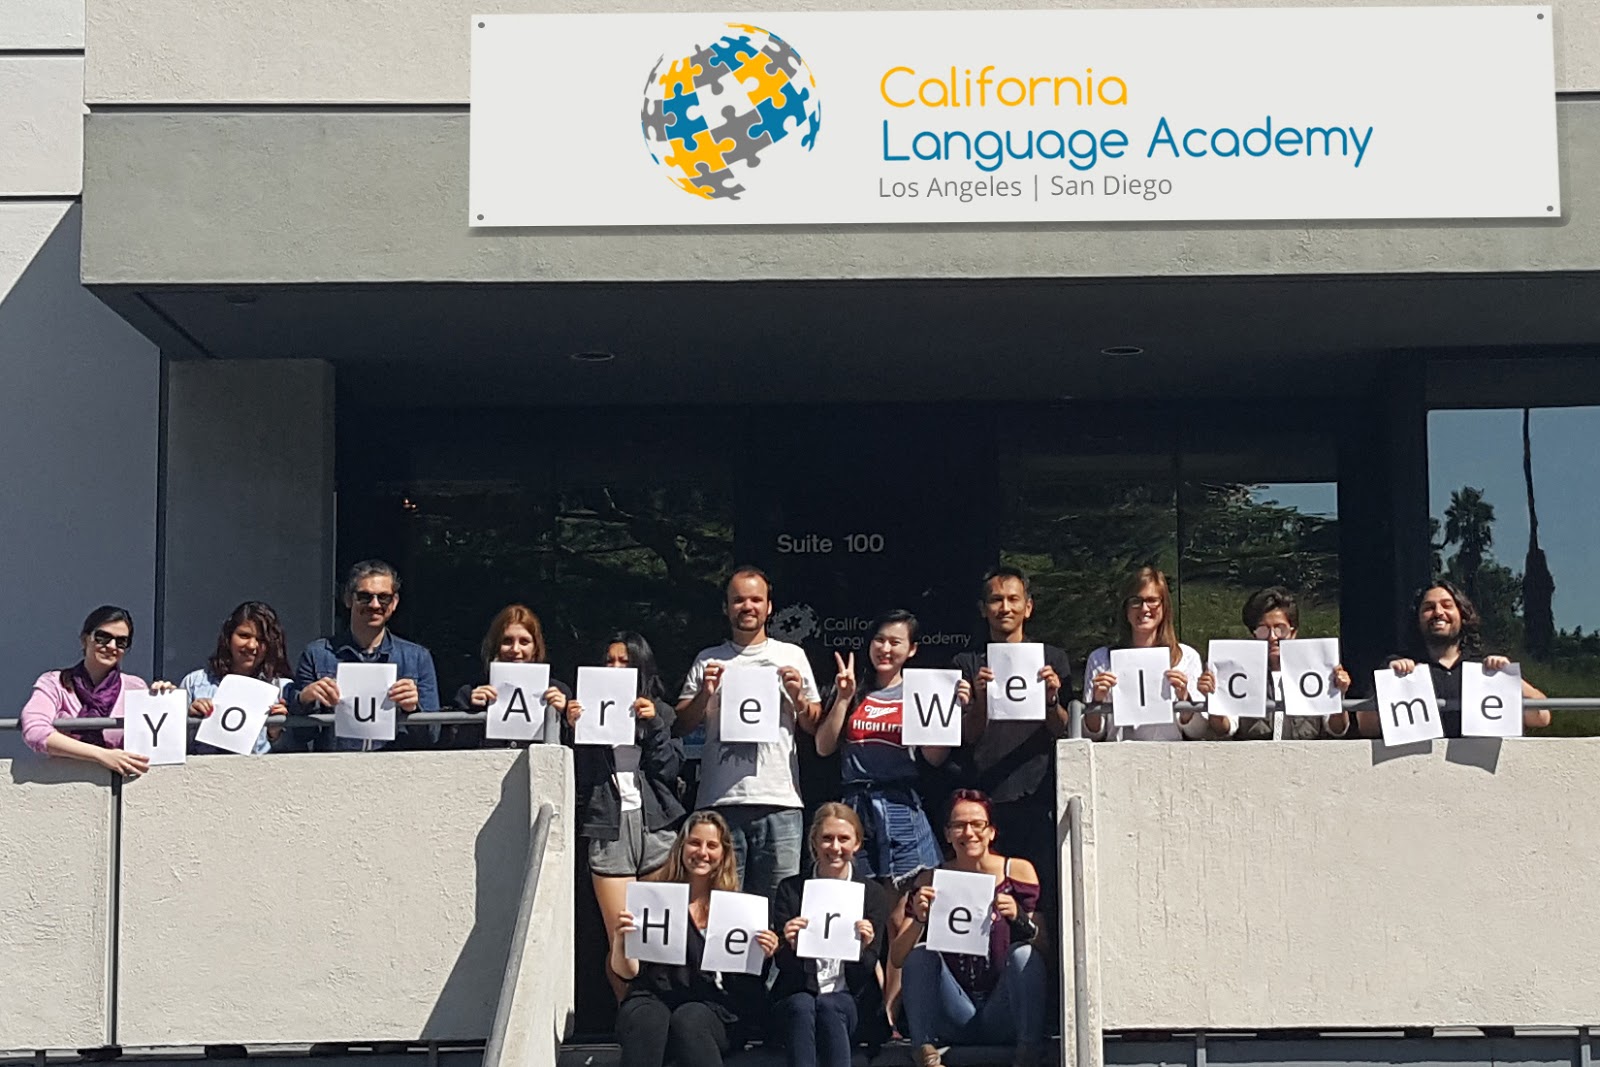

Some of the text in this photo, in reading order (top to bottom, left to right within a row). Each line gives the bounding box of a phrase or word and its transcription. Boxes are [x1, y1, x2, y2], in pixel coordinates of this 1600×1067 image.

[880, 65, 1129, 109] California
[882, 115, 1374, 172] Language Academy
[879, 177, 919, 198] Los
[926, 175, 1022, 203] Angeles
[1050, 175, 1095, 196] San
[1103, 174, 1173, 201] Diego
[777, 533, 885, 553] Suite 100
[823, 616, 874, 631] Califor
[1005, 675, 1027, 702] e
[353, 696, 376, 723] u
[502, 687, 531, 723] A
[599, 700, 615, 726] r
[739, 698, 762, 724] e
[913, 692, 958, 728] W
[1390, 698, 1430, 727] m
[1481, 695, 1503, 720] e
[144, 712, 168, 747] Y
[852, 719, 880, 731] HIGH
[641, 907, 670, 946] H
[824, 912, 841, 940] r
[948, 906, 972, 935] e
[724, 928, 749, 955] e
